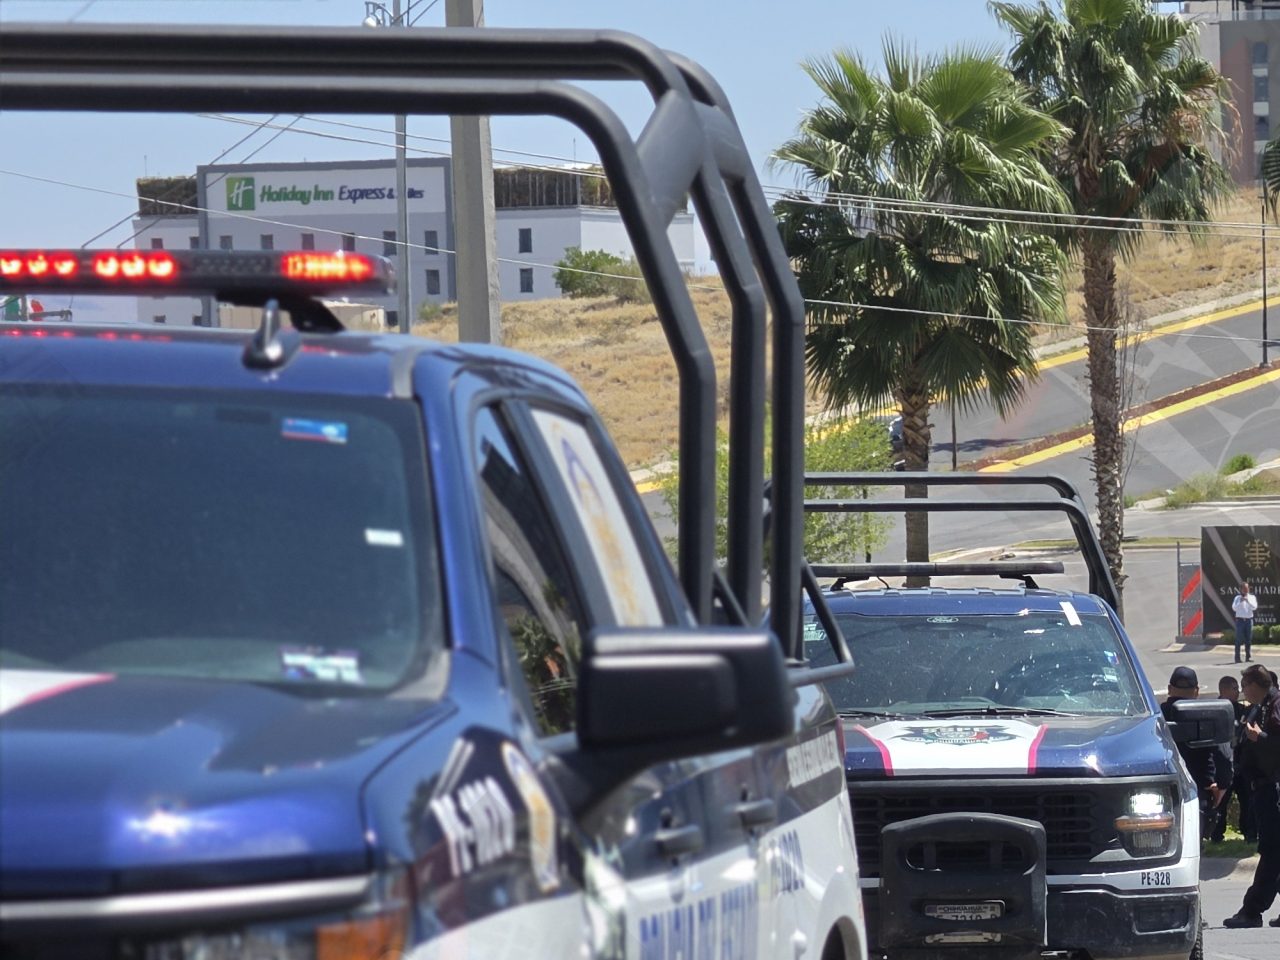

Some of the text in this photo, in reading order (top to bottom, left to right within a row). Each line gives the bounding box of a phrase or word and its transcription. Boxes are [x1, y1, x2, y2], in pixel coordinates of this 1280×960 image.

[260, 185, 311, 205] Holiday
[314, 185, 334, 201] Inn
[339, 185, 385, 204] Express
[1141, 871, 1171, 886] PE-328
